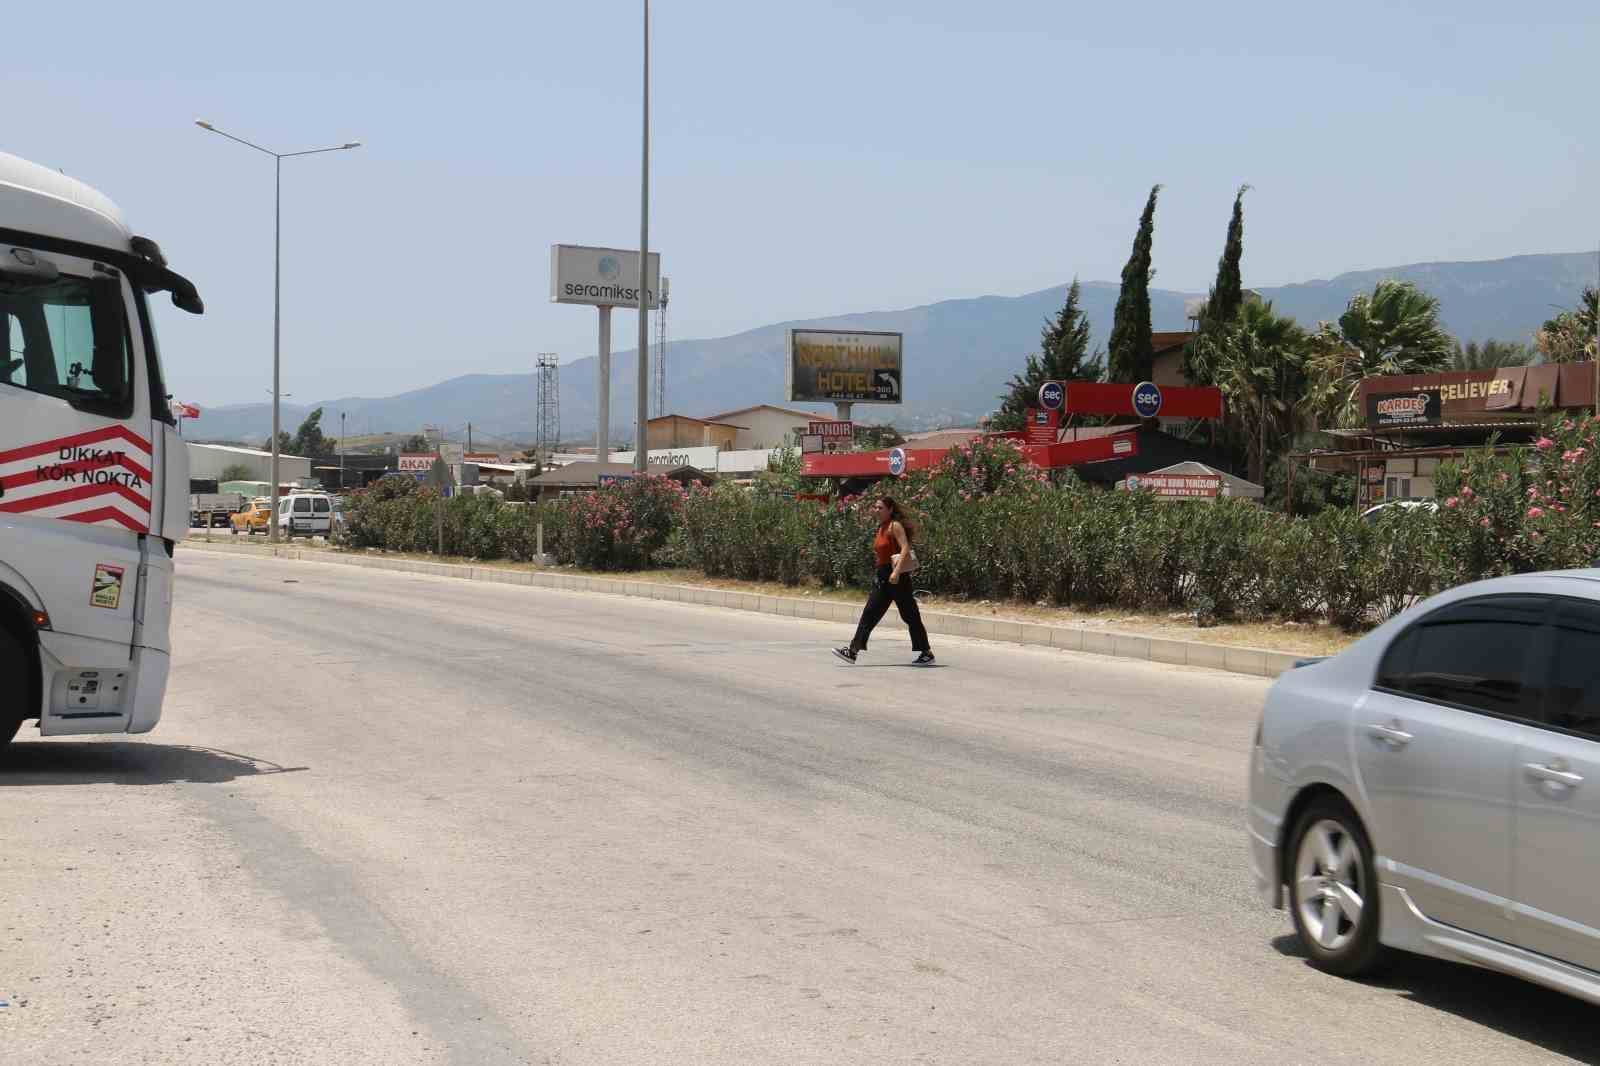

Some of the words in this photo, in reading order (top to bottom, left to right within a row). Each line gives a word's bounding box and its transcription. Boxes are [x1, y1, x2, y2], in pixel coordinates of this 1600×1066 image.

[816, 370, 874, 393] HOTEL
[59, 444, 126, 466] DİKKAT
[36, 463, 76, 482] KÖR
[82, 469, 142, 488] NOKTA
